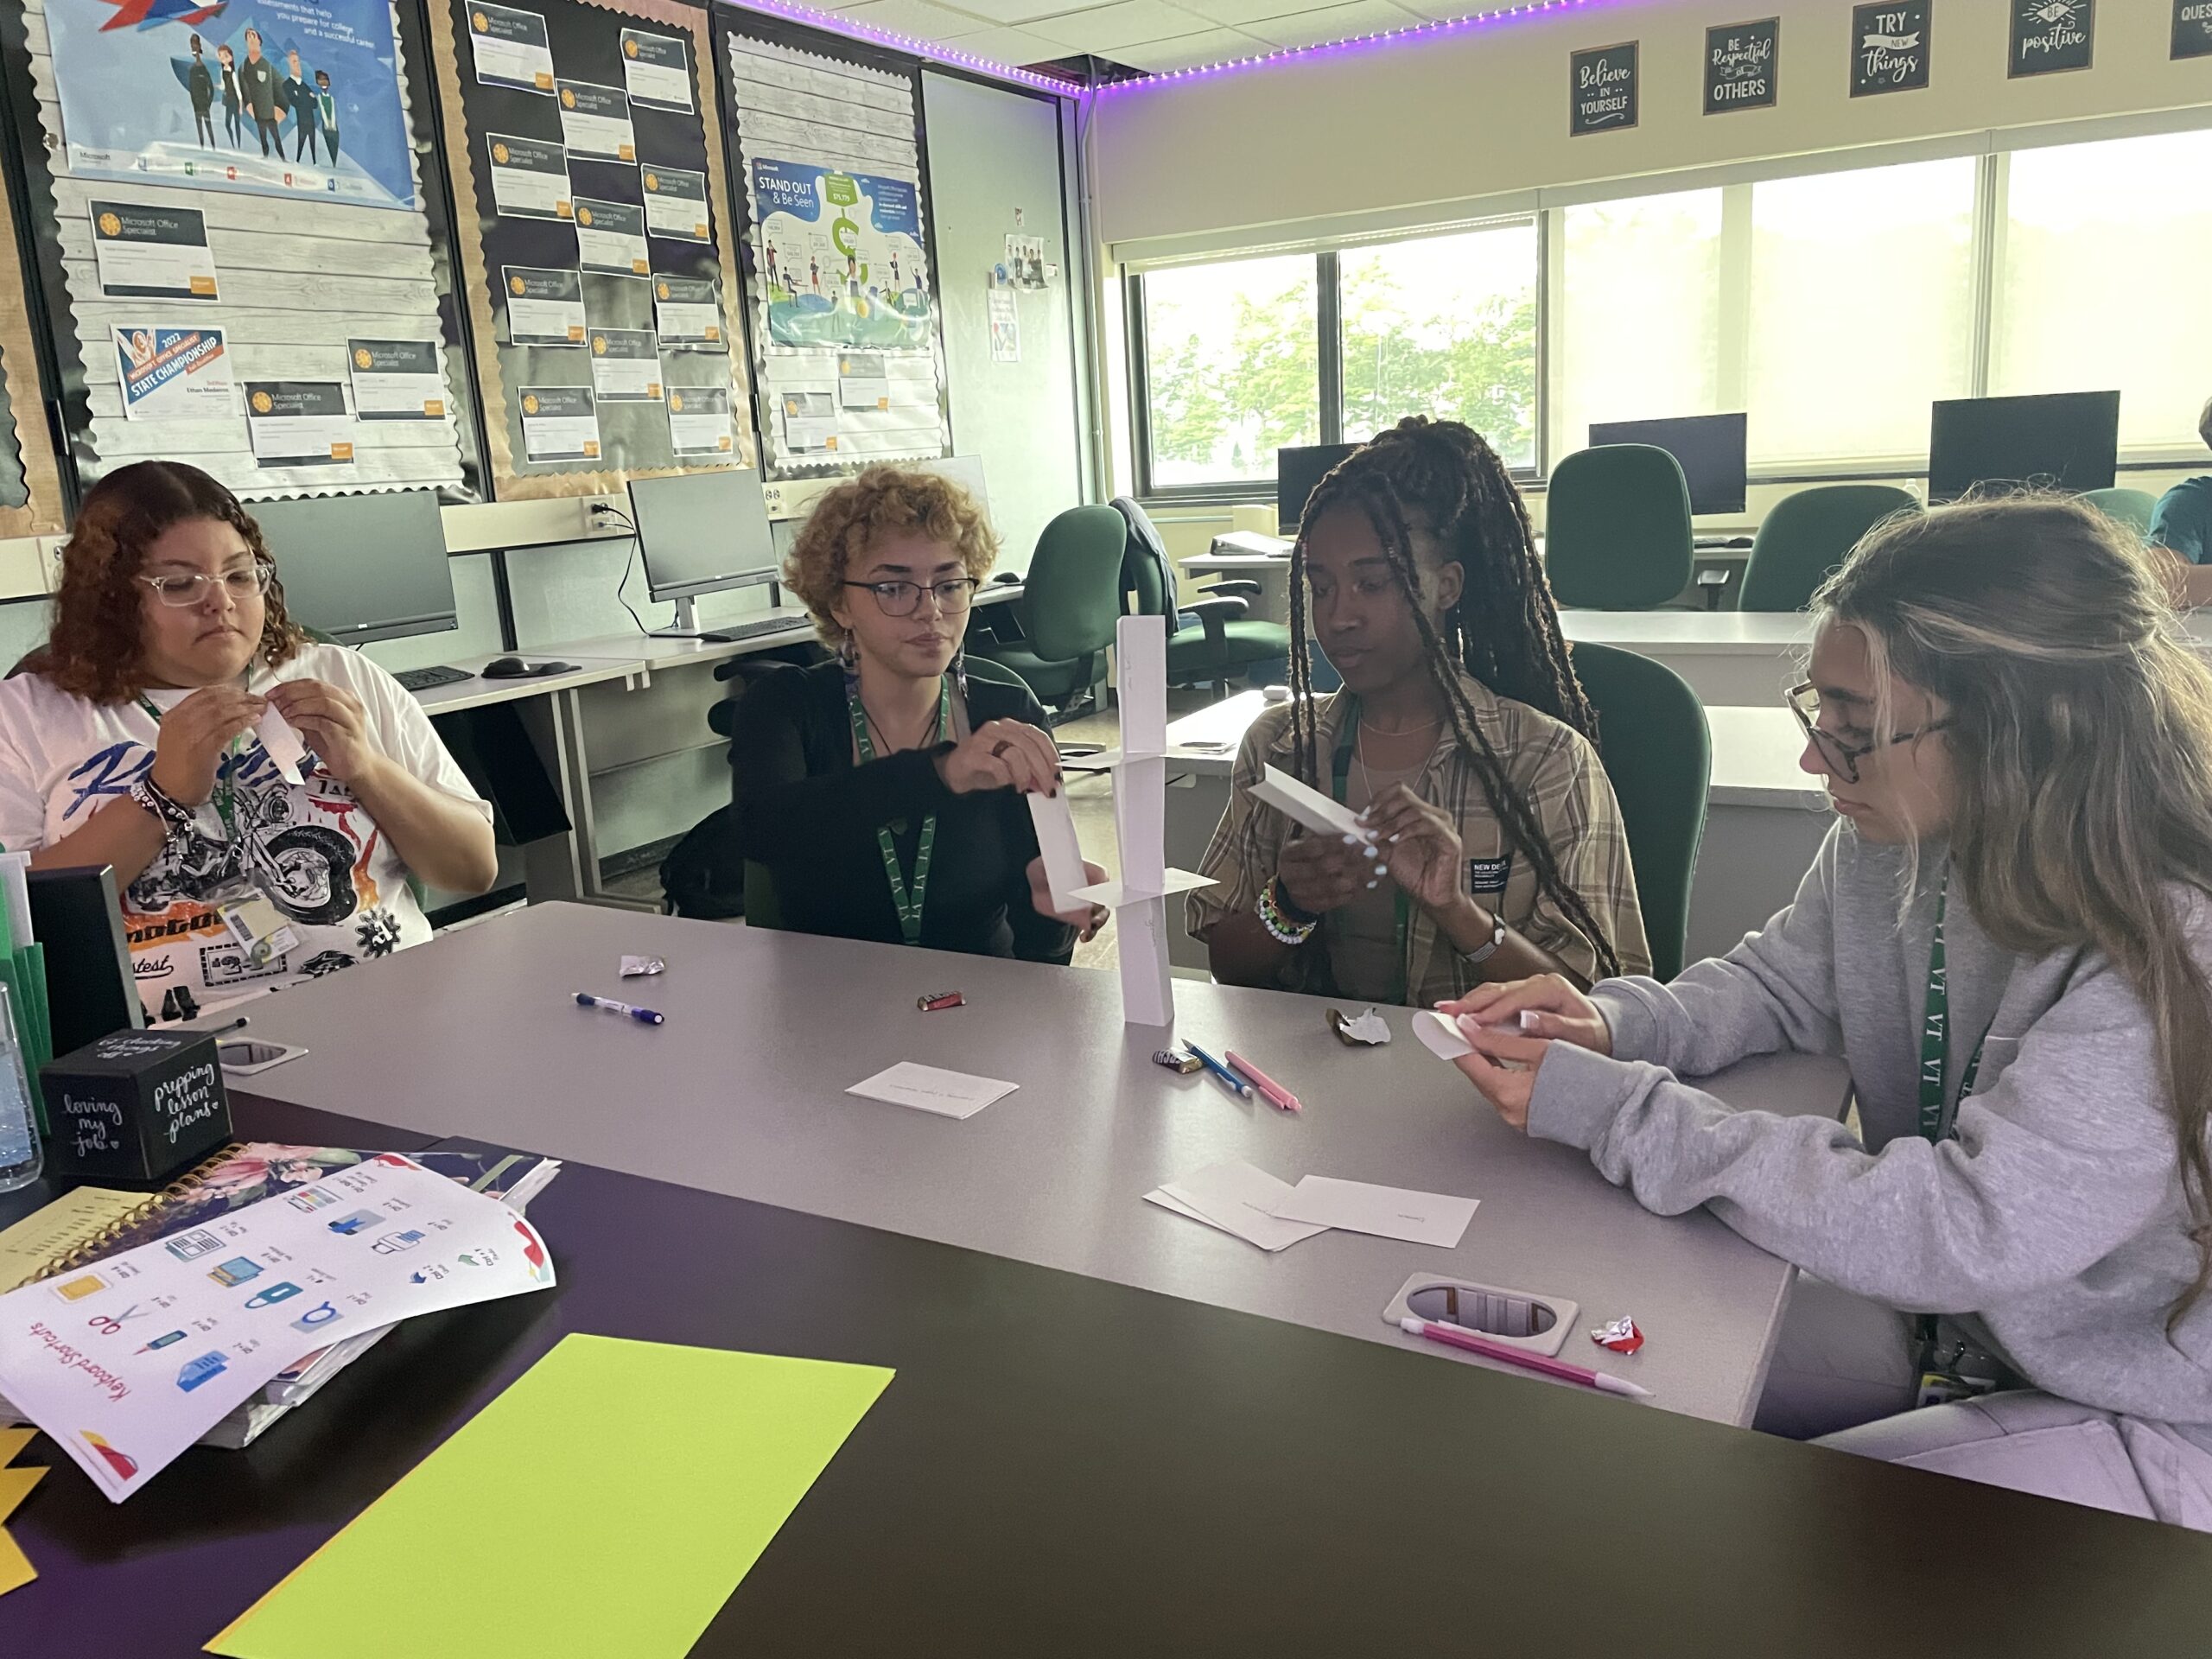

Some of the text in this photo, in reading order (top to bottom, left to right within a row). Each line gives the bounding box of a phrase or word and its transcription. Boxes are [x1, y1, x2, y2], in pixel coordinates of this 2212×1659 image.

[2047, 5, 2059, 17] BE
[2182, 3, 2212, 21] QUES
[1875, 11, 1906, 34] TRY
[1728, 38, 1740, 51] BE
[1891, 38, 1909, 48] NEW
[2022, 21, 2086, 59] positive
[1712, 38, 1771, 67] Respectful
[1579, 59, 1631, 89] Believe
[1860, 47, 1918, 82] things
[1599, 87, 1611, 97] IN
[1713, 79, 1765, 101] OTHERS
[1580, 96, 1628, 115] YOURSELF
[759, 176, 811, 195] STAND OUT
[772, 192, 814, 208] & Be Seen
[121, 217, 179, 229] Microsoft Office
[162, 333, 181, 348] 2022
[130, 336, 217, 397] STATE CHAMPIONSHIP
[302, 392, 321, 401] Office
[1930, 968, 1946, 995] VT
[1926, 1014, 1943, 1041] VT
[1923, 1058, 1941, 1086] VT
[154, 1063, 215, 1112] prepping
[63, 1094, 123, 1126] loving
[167, 1084, 209, 1116] lesson
[78, 1118, 106, 1140] my
[163, 1103, 212, 1143] plans
[70, 1135, 108, 1157] job
[29, 1322, 132, 1402] Keyboard Shortcuts
